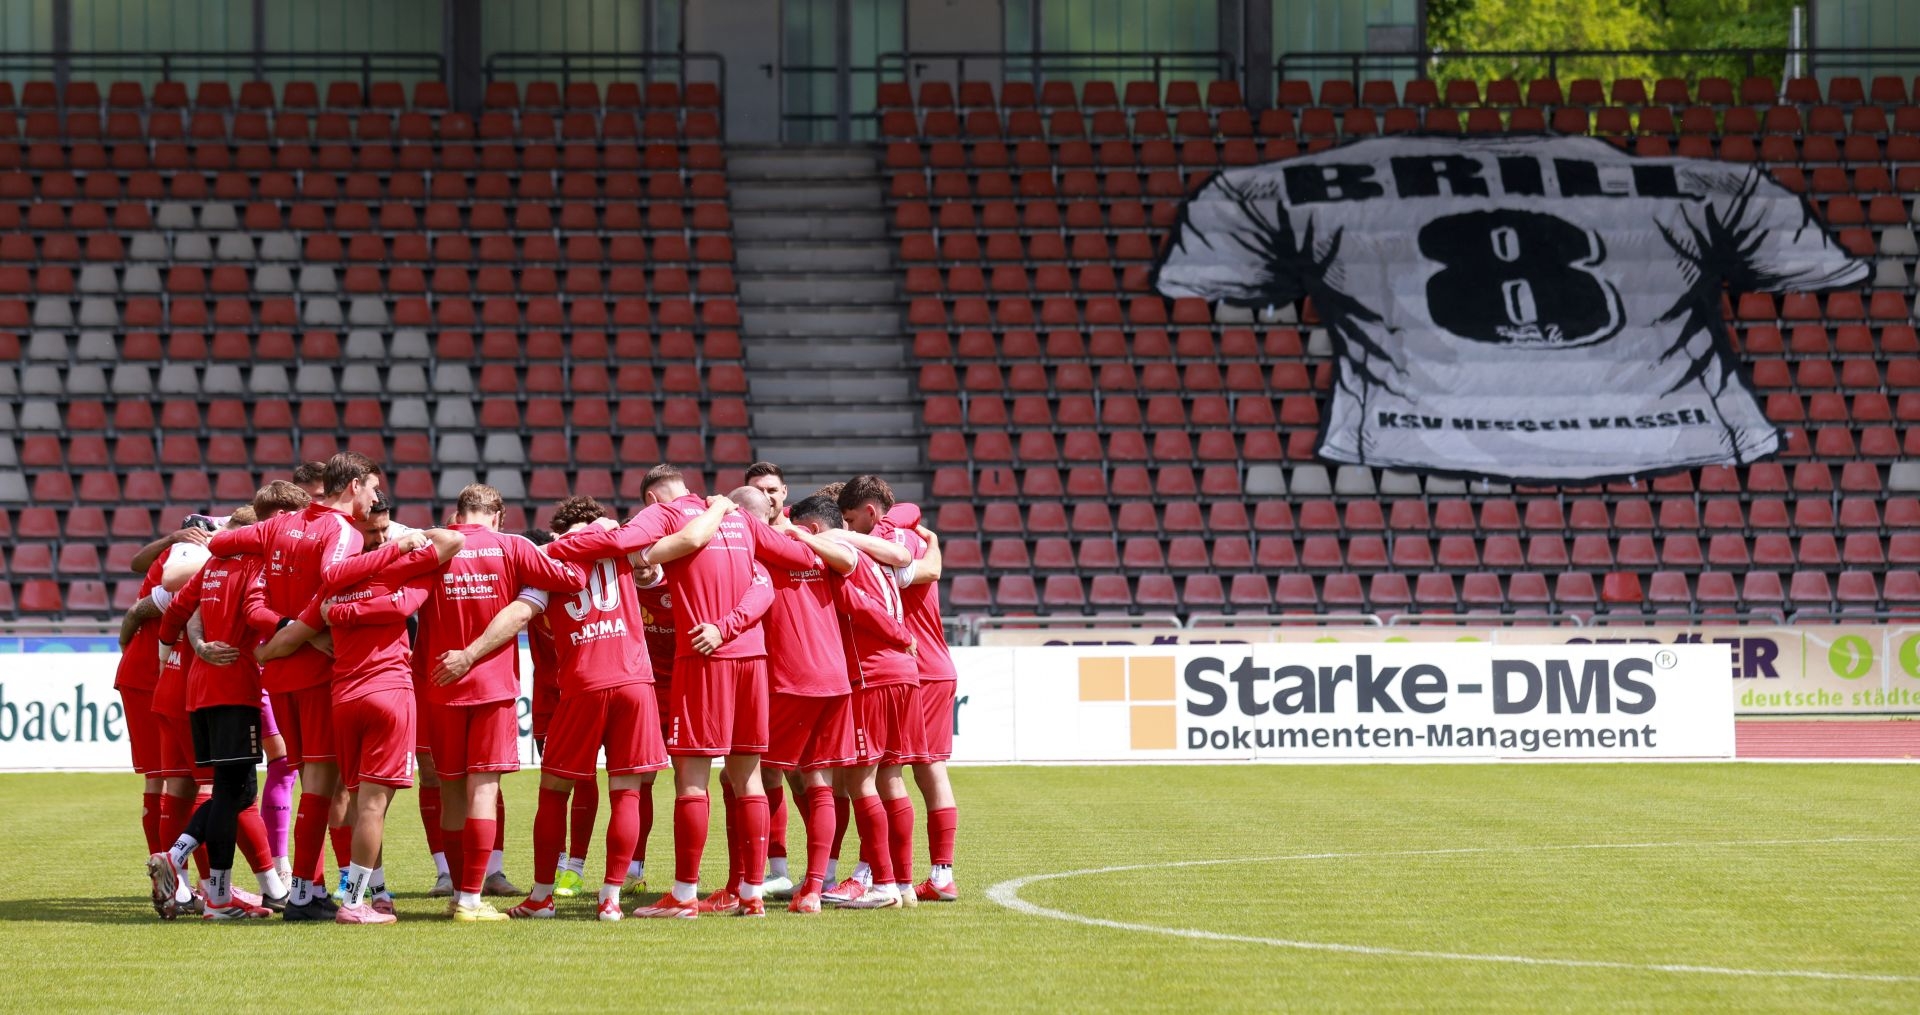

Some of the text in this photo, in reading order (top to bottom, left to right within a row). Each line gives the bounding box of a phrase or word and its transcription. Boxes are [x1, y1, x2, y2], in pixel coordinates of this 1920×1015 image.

[1283, 154, 1706, 205] BRILL
[1417, 208, 1624, 348] 8
[1378, 411, 1443, 430] KSV
[1588, 408, 1711, 430] KASSEL
[454, 547, 504, 559] ESSEN KASSEL
[456, 573, 498, 582] württem
[338, 589, 373, 602] württem
[445, 584, 493, 595] bergische
[1741, 687, 1843, 707] deutsche
[1188, 723, 1657, 751] Dokumenten-Management
